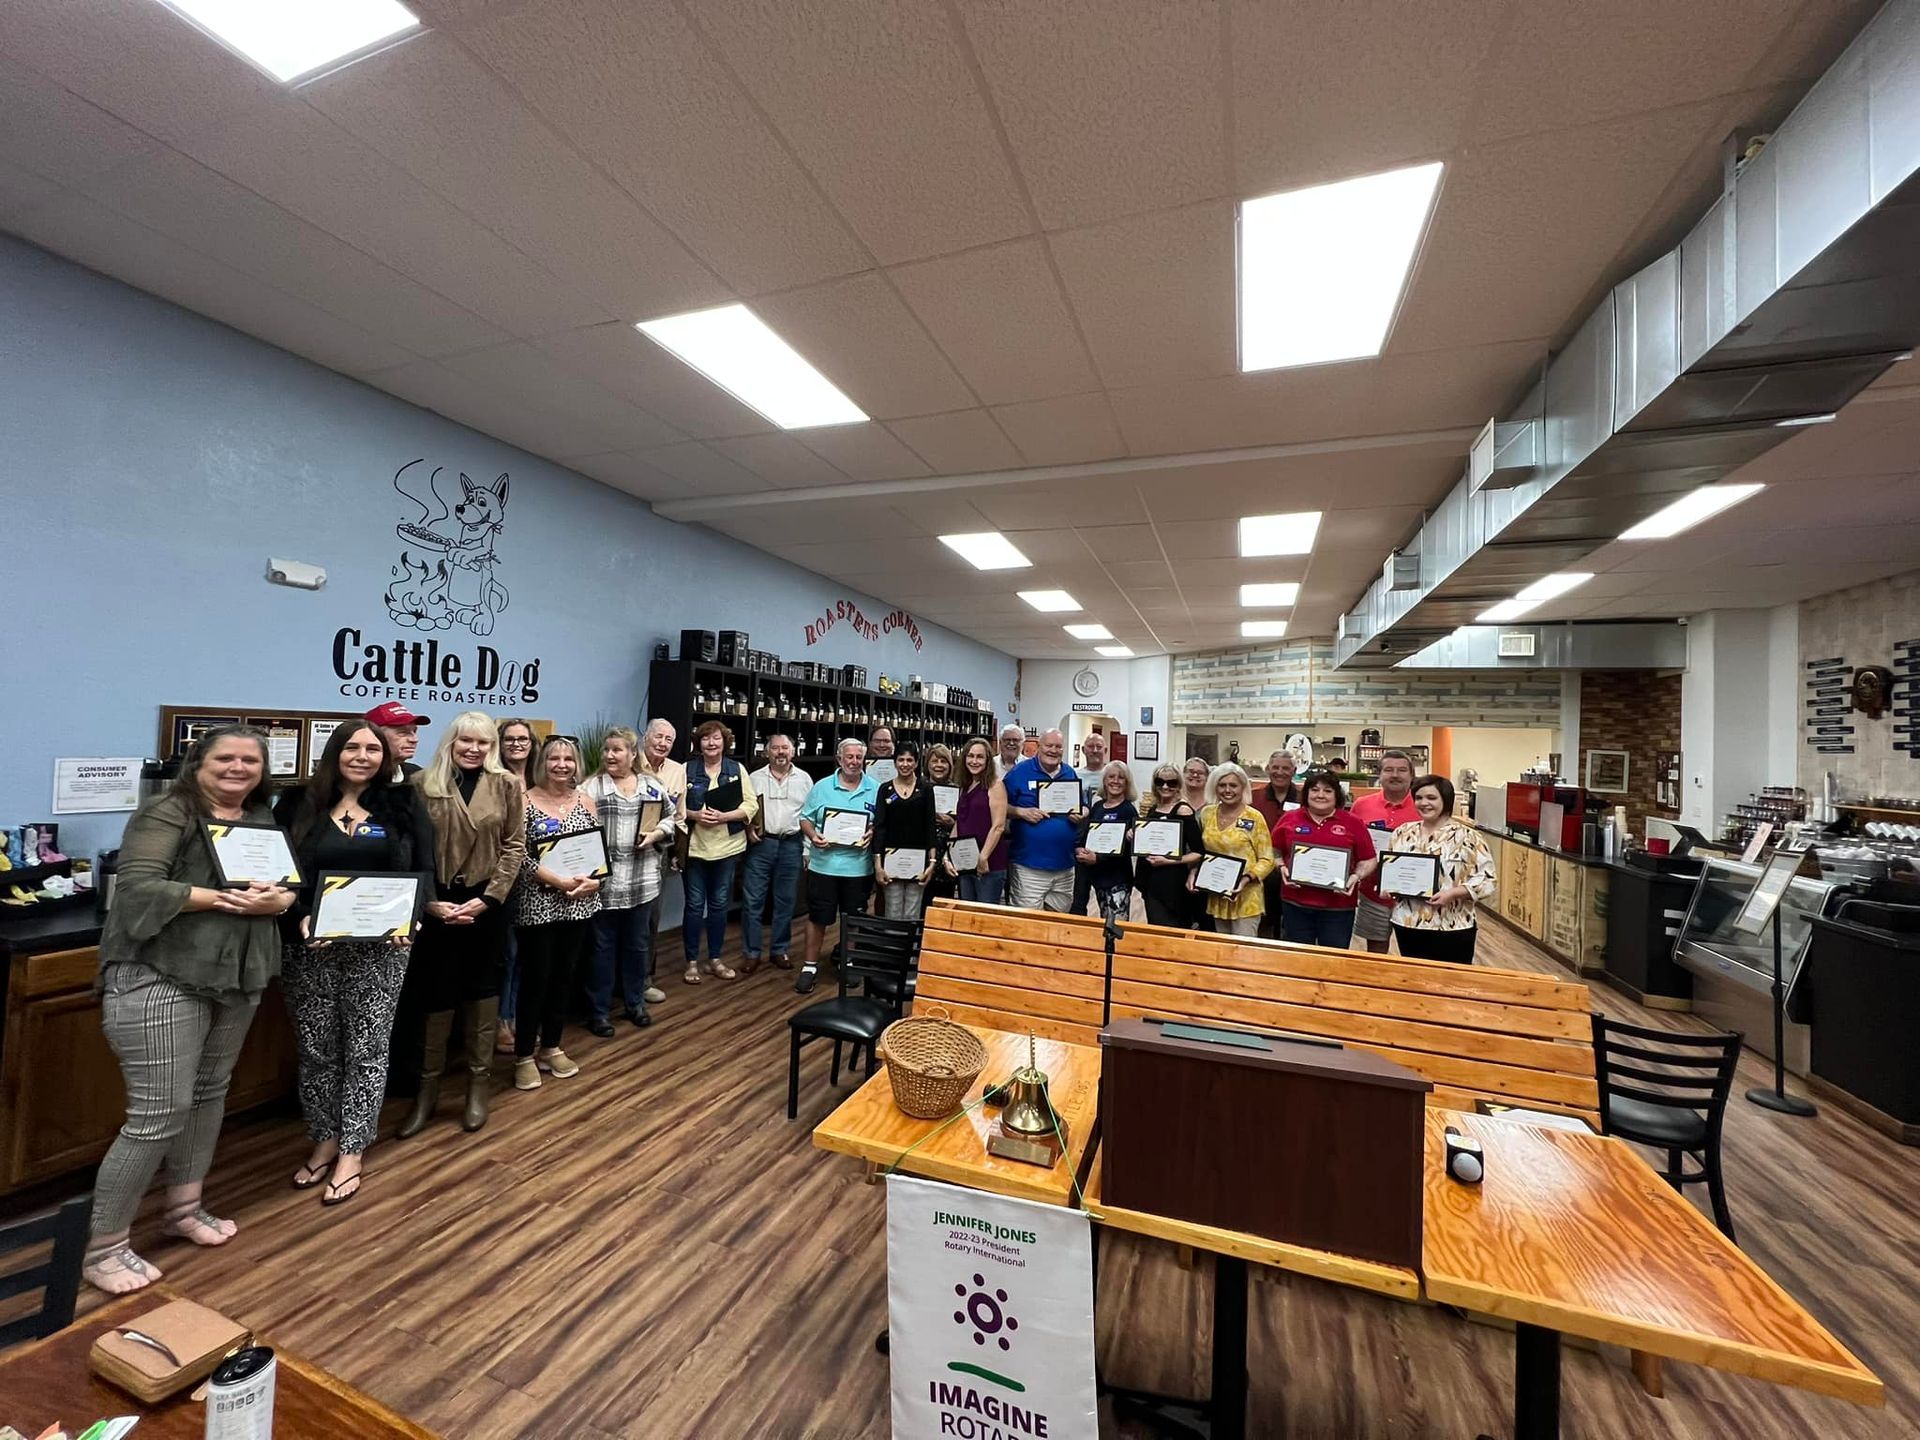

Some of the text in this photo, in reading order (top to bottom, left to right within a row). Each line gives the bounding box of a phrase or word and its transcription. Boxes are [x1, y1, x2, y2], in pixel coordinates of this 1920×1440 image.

[804, 600, 923, 655] ROASTERS CORNER
[332, 627, 541, 704] Cattle Dog
[339, 683, 517, 706] COFFEE ROASTERS
[933, 1211, 1037, 1244] JENNIFER JONES
[949, 1230, 1021, 1256] 2022-23 President
[944, 1240, 1026, 1268] Rotary International
[929, 1381, 1048, 1439] IMAGINE
